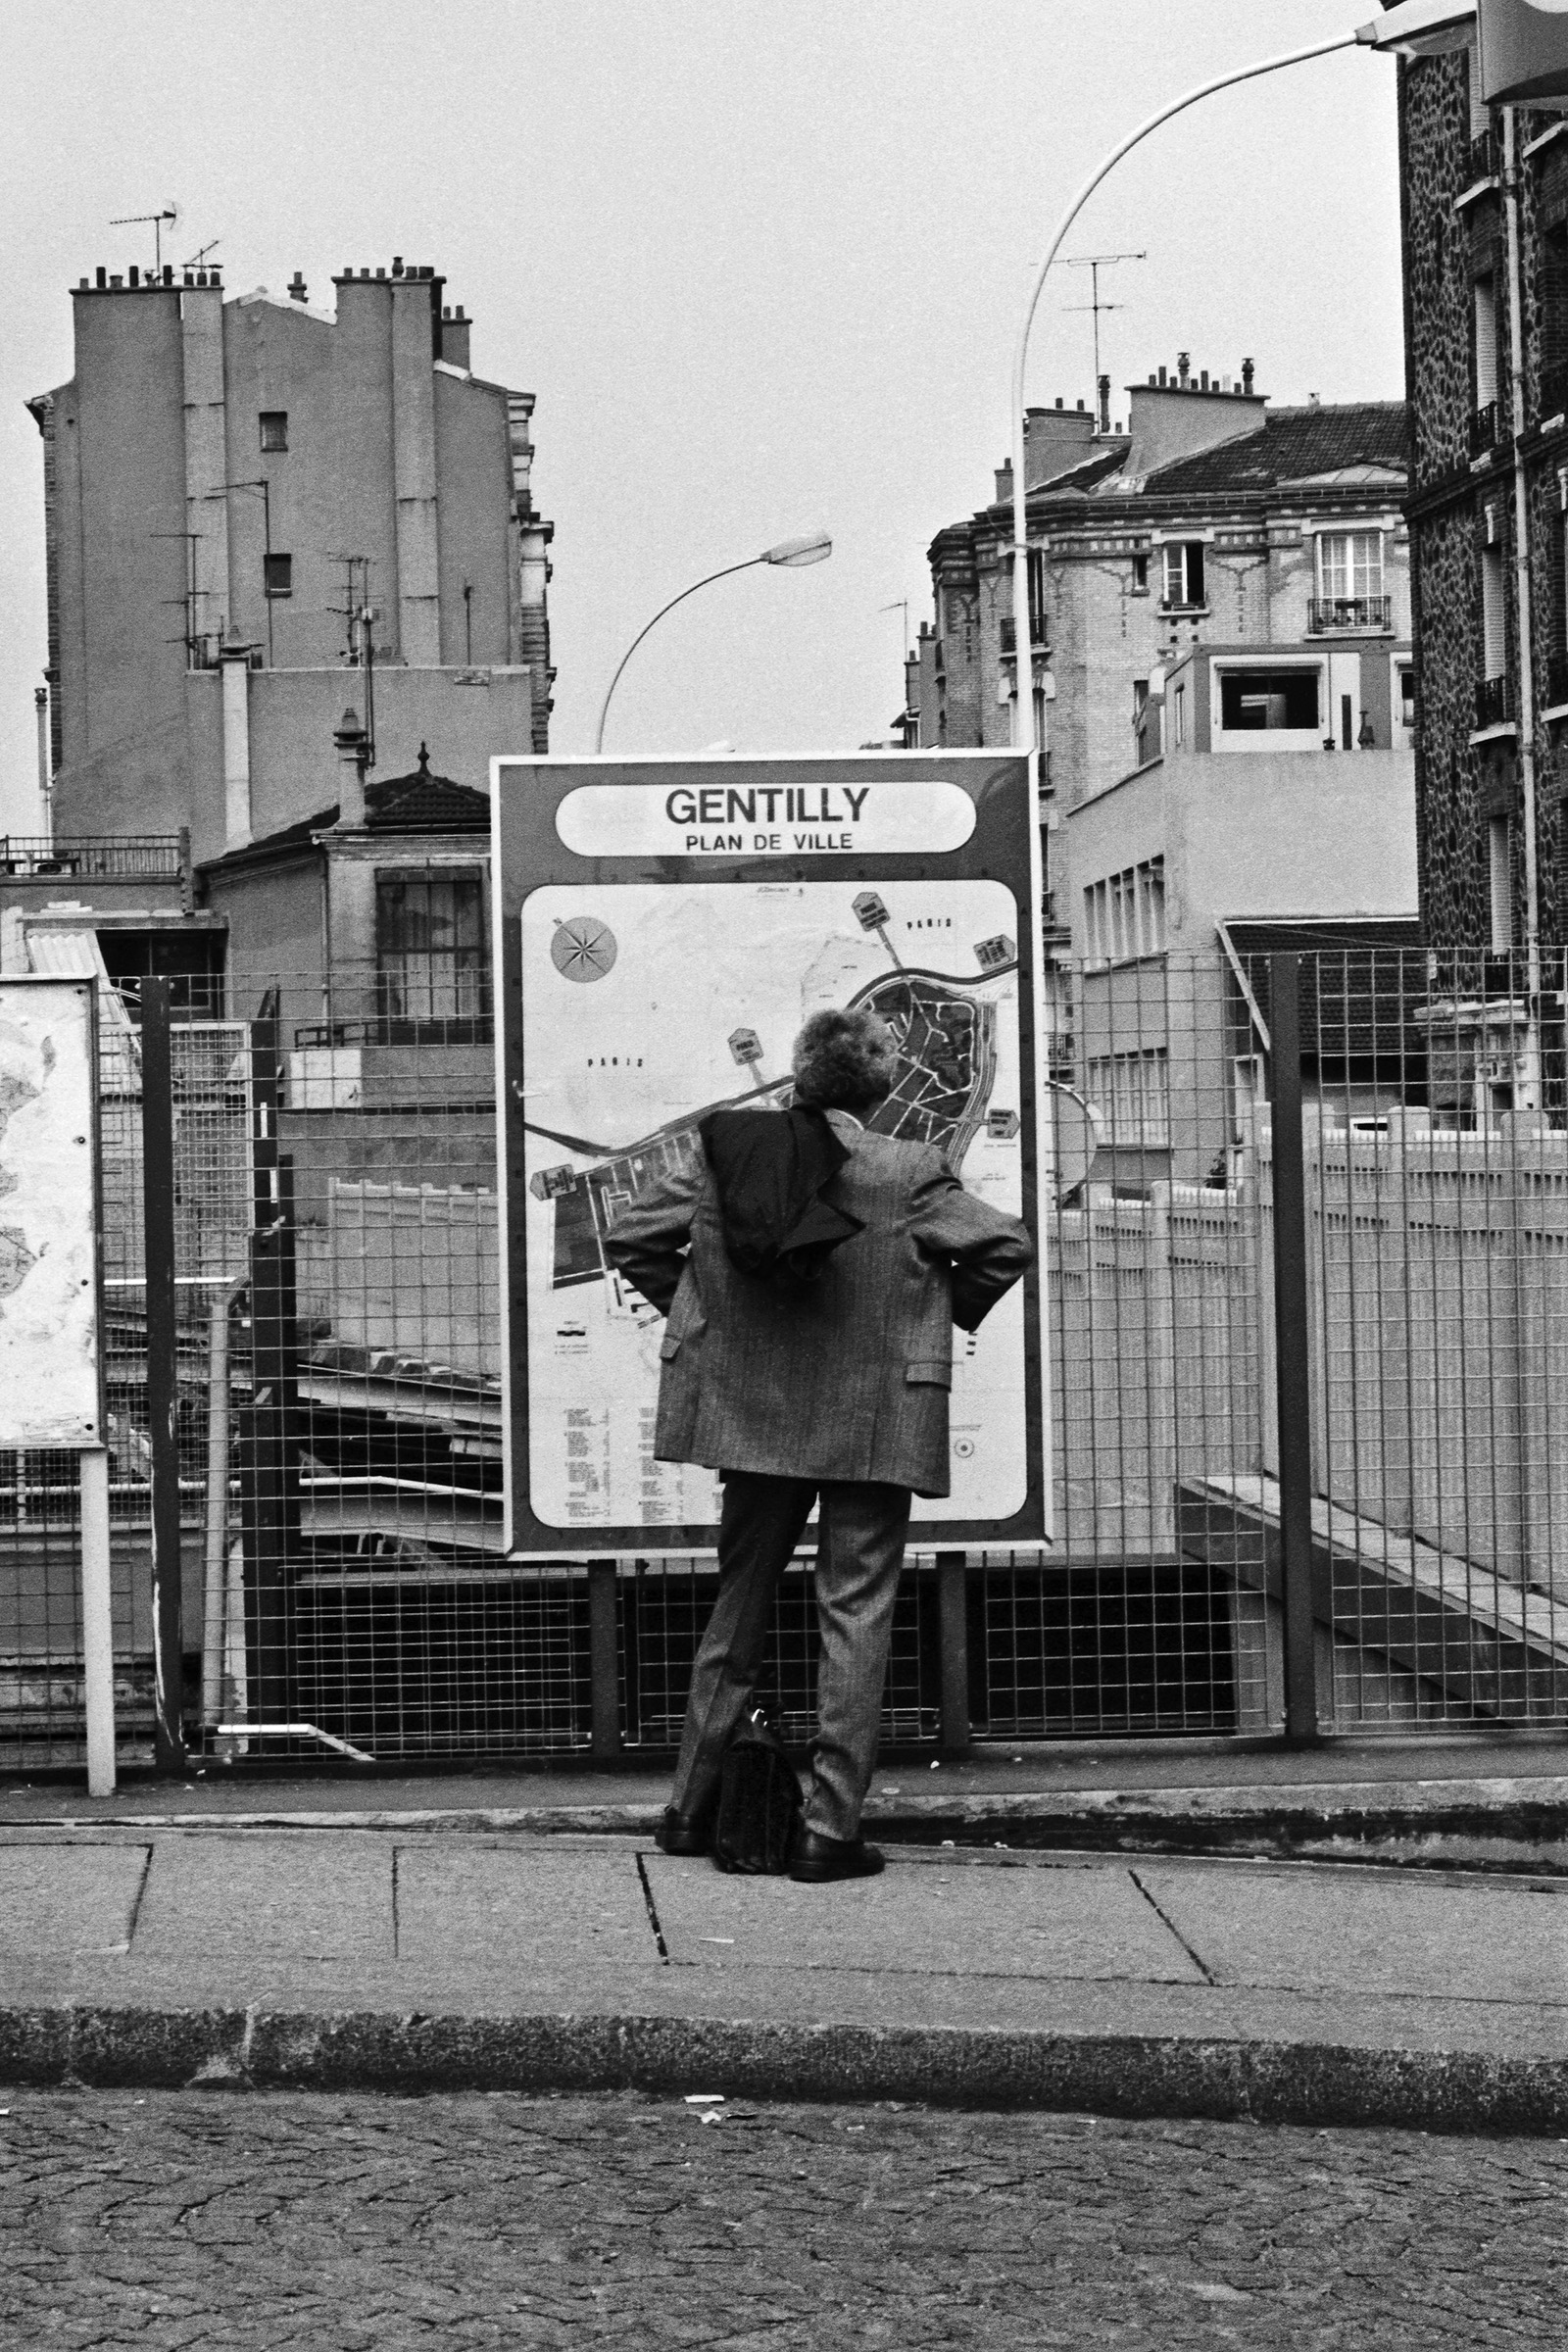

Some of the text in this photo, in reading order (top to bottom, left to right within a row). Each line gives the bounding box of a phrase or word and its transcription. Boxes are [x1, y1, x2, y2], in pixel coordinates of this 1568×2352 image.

[665, 788, 870, 824] GENTILLY
[686, 833, 854, 851] PLAN DE VILLE
